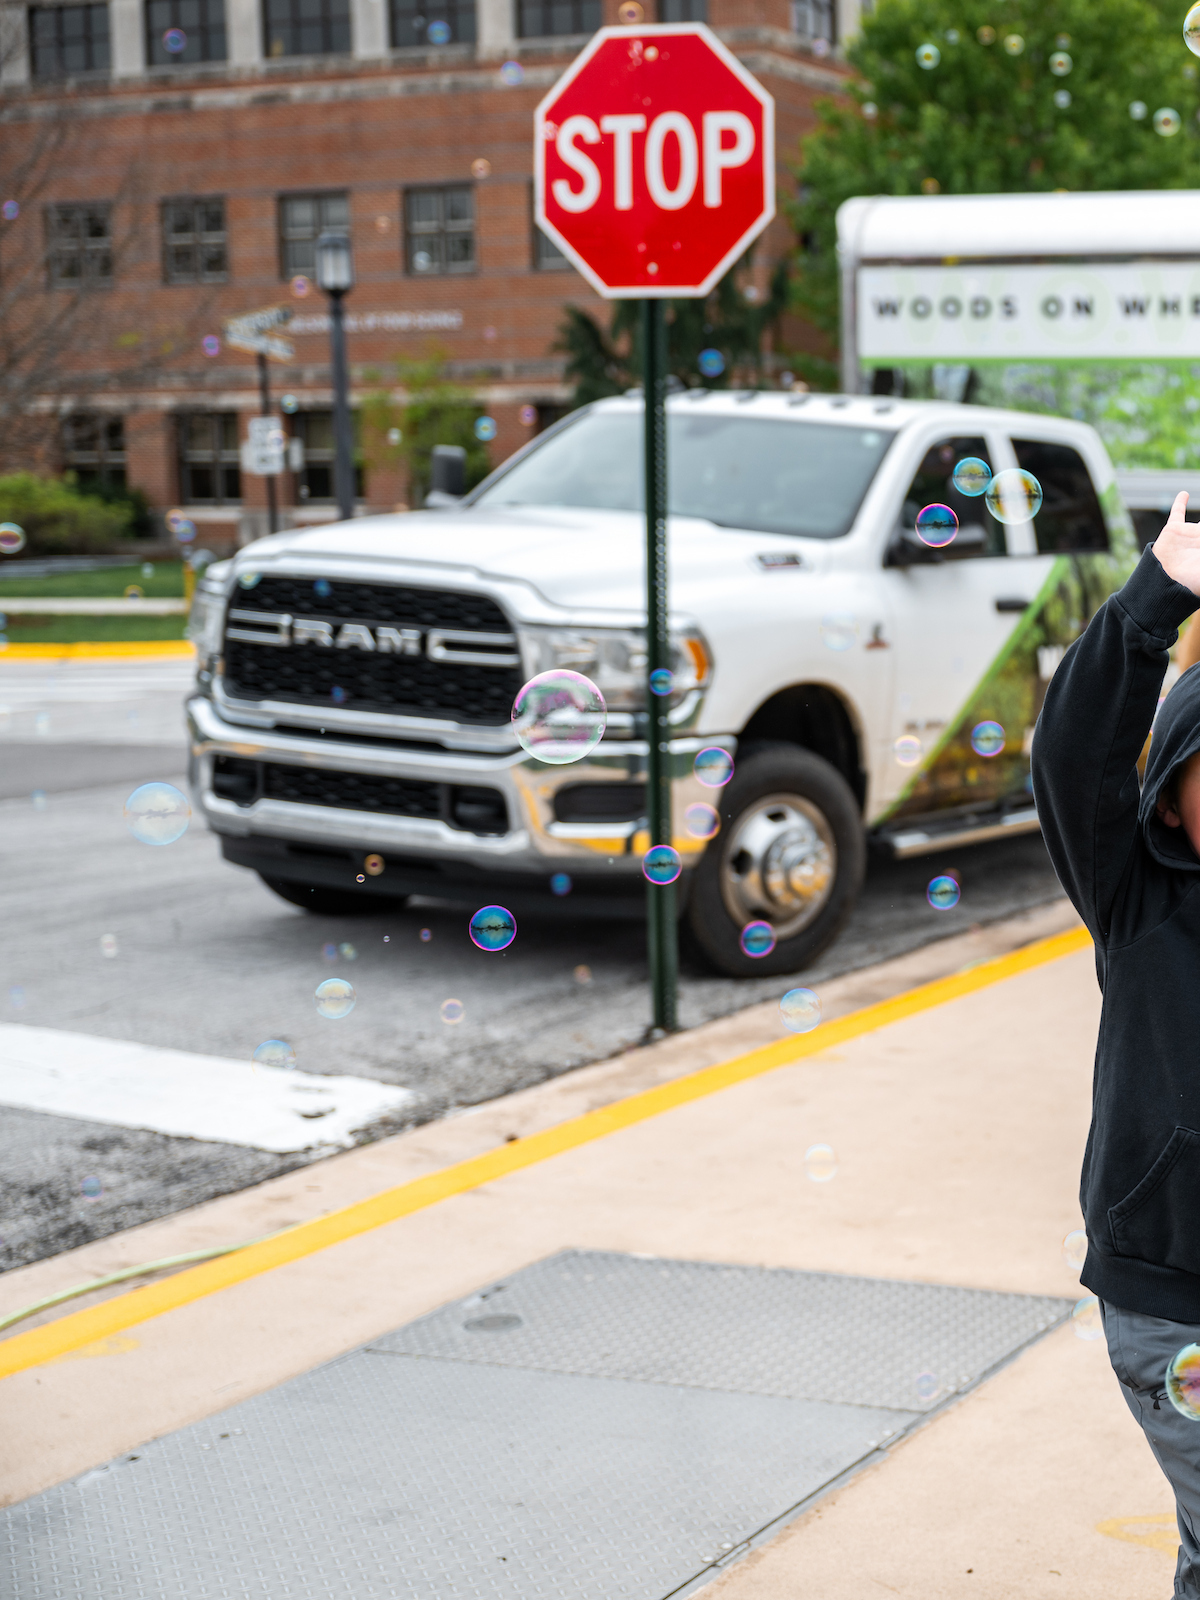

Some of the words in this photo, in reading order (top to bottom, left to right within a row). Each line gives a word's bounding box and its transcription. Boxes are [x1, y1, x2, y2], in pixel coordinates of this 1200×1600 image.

[552, 111, 756, 213] STOP
[873, 297, 1017, 320] WOODS
[1041, 297, 1095, 319] ON
[293, 619, 421, 655] RAM
